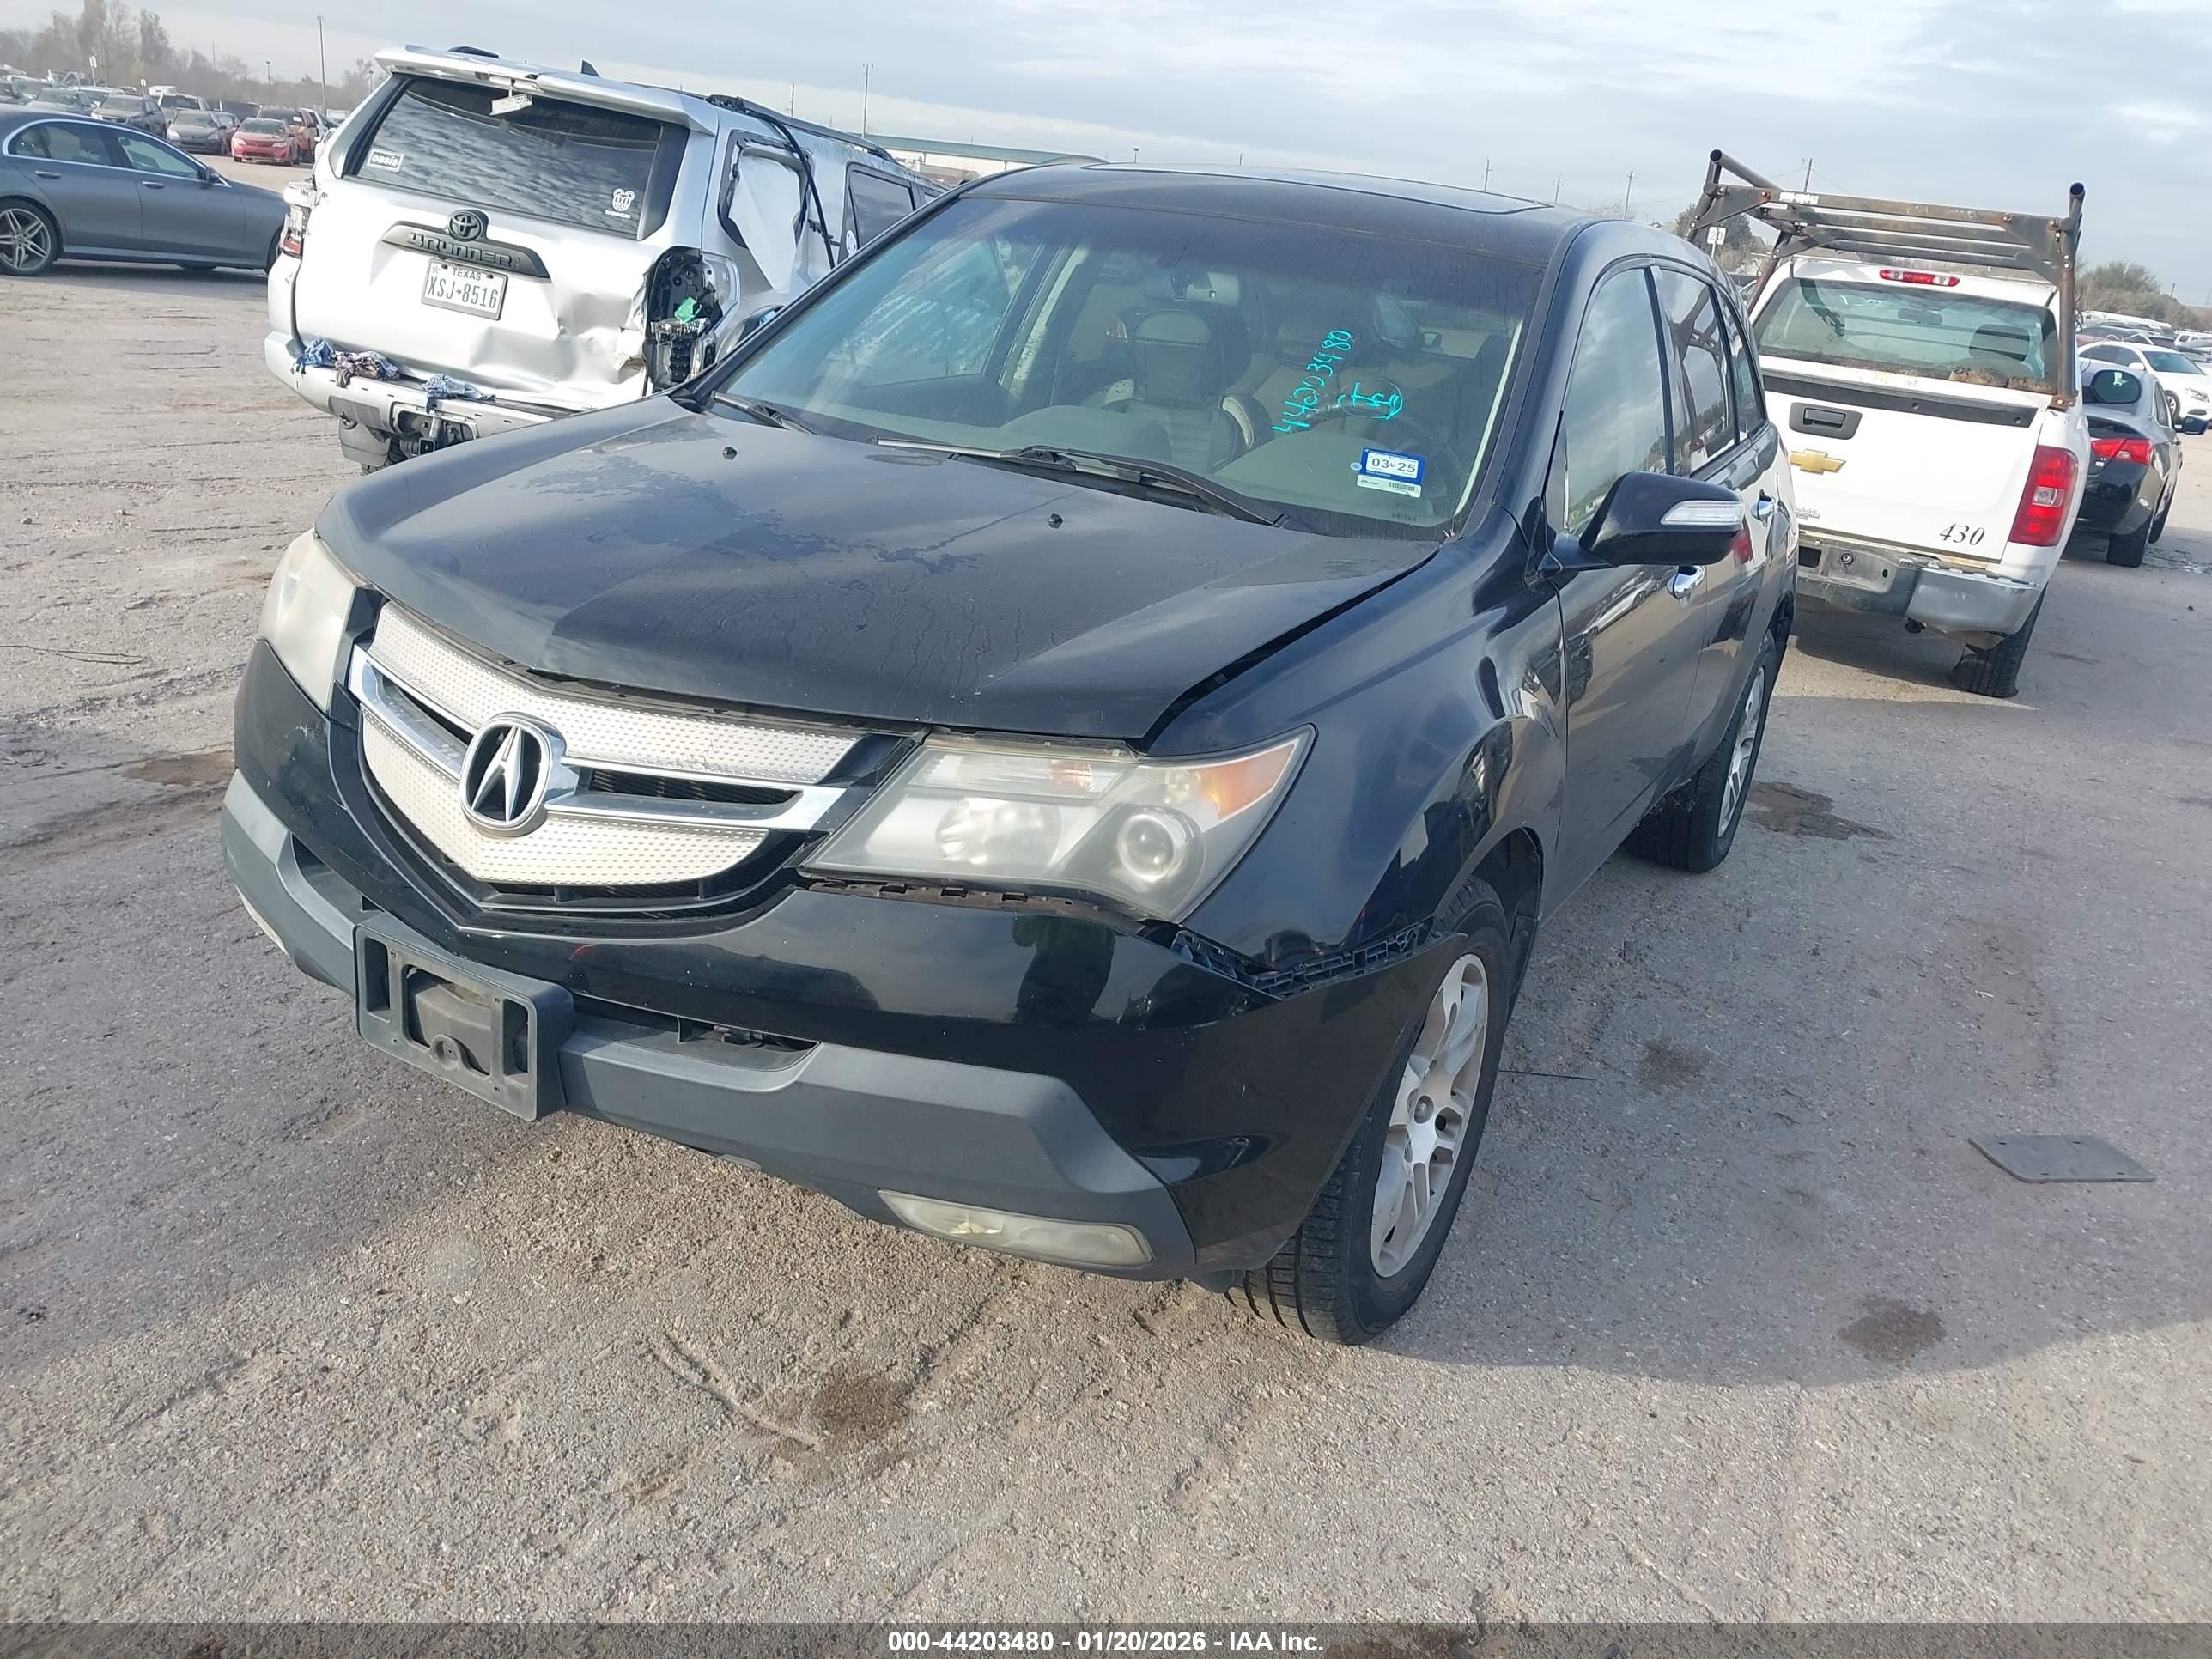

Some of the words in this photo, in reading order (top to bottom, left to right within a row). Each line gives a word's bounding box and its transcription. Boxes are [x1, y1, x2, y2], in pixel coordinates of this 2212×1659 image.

[371, 154, 399, 167] oasis
[407, 231, 514, 268] 4RUNNER
[452, 266, 482, 282] TEXAS
[1272, 329, 1353, 434] 44203480
[1939, 522, 1986, 546] 430
